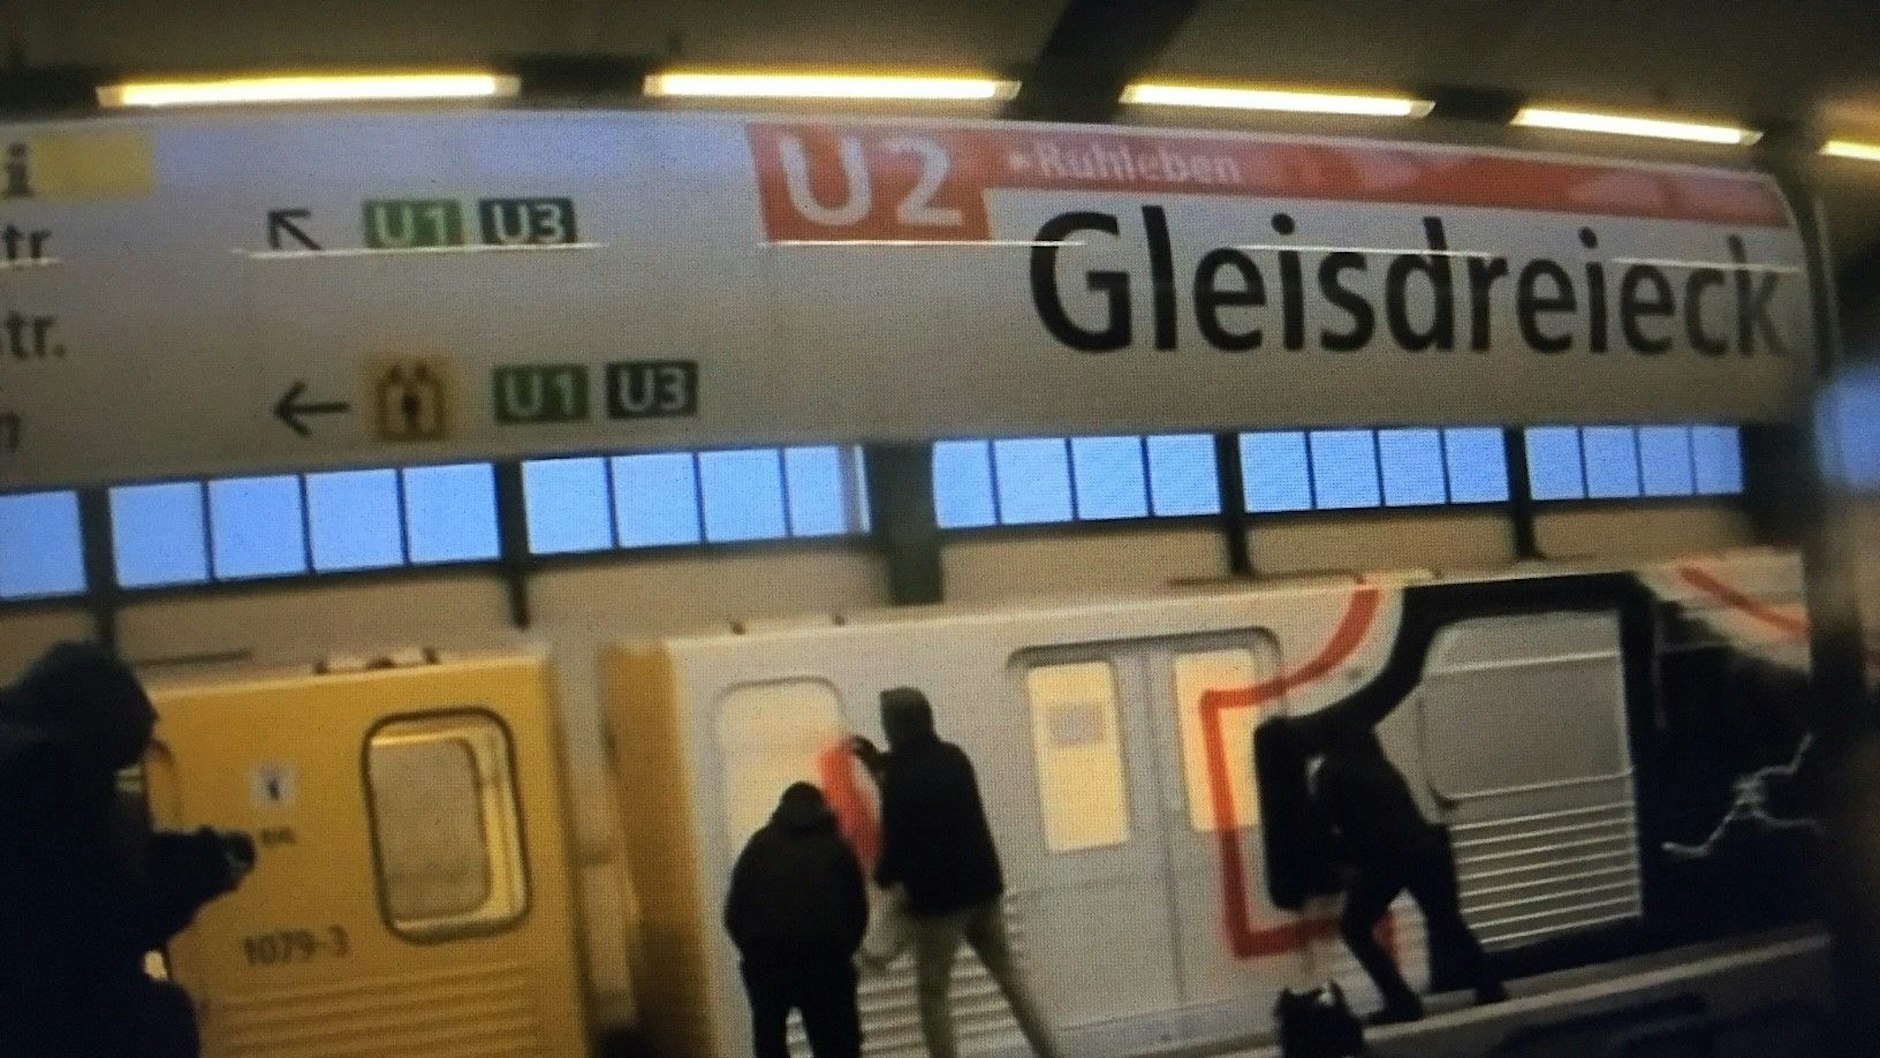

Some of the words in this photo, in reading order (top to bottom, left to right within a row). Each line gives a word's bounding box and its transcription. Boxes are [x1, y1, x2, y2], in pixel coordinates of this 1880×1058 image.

[778, 135, 963, 226] U2
[1036, 140, 1240, 184] Ruhleben
[375, 203, 449, 246] U1
[491, 202, 566, 244] U3
[1030, 204, 1794, 356] Gleisdreieck
[503, 370, 577, 417] U1
[619, 367, 688, 414] U3
